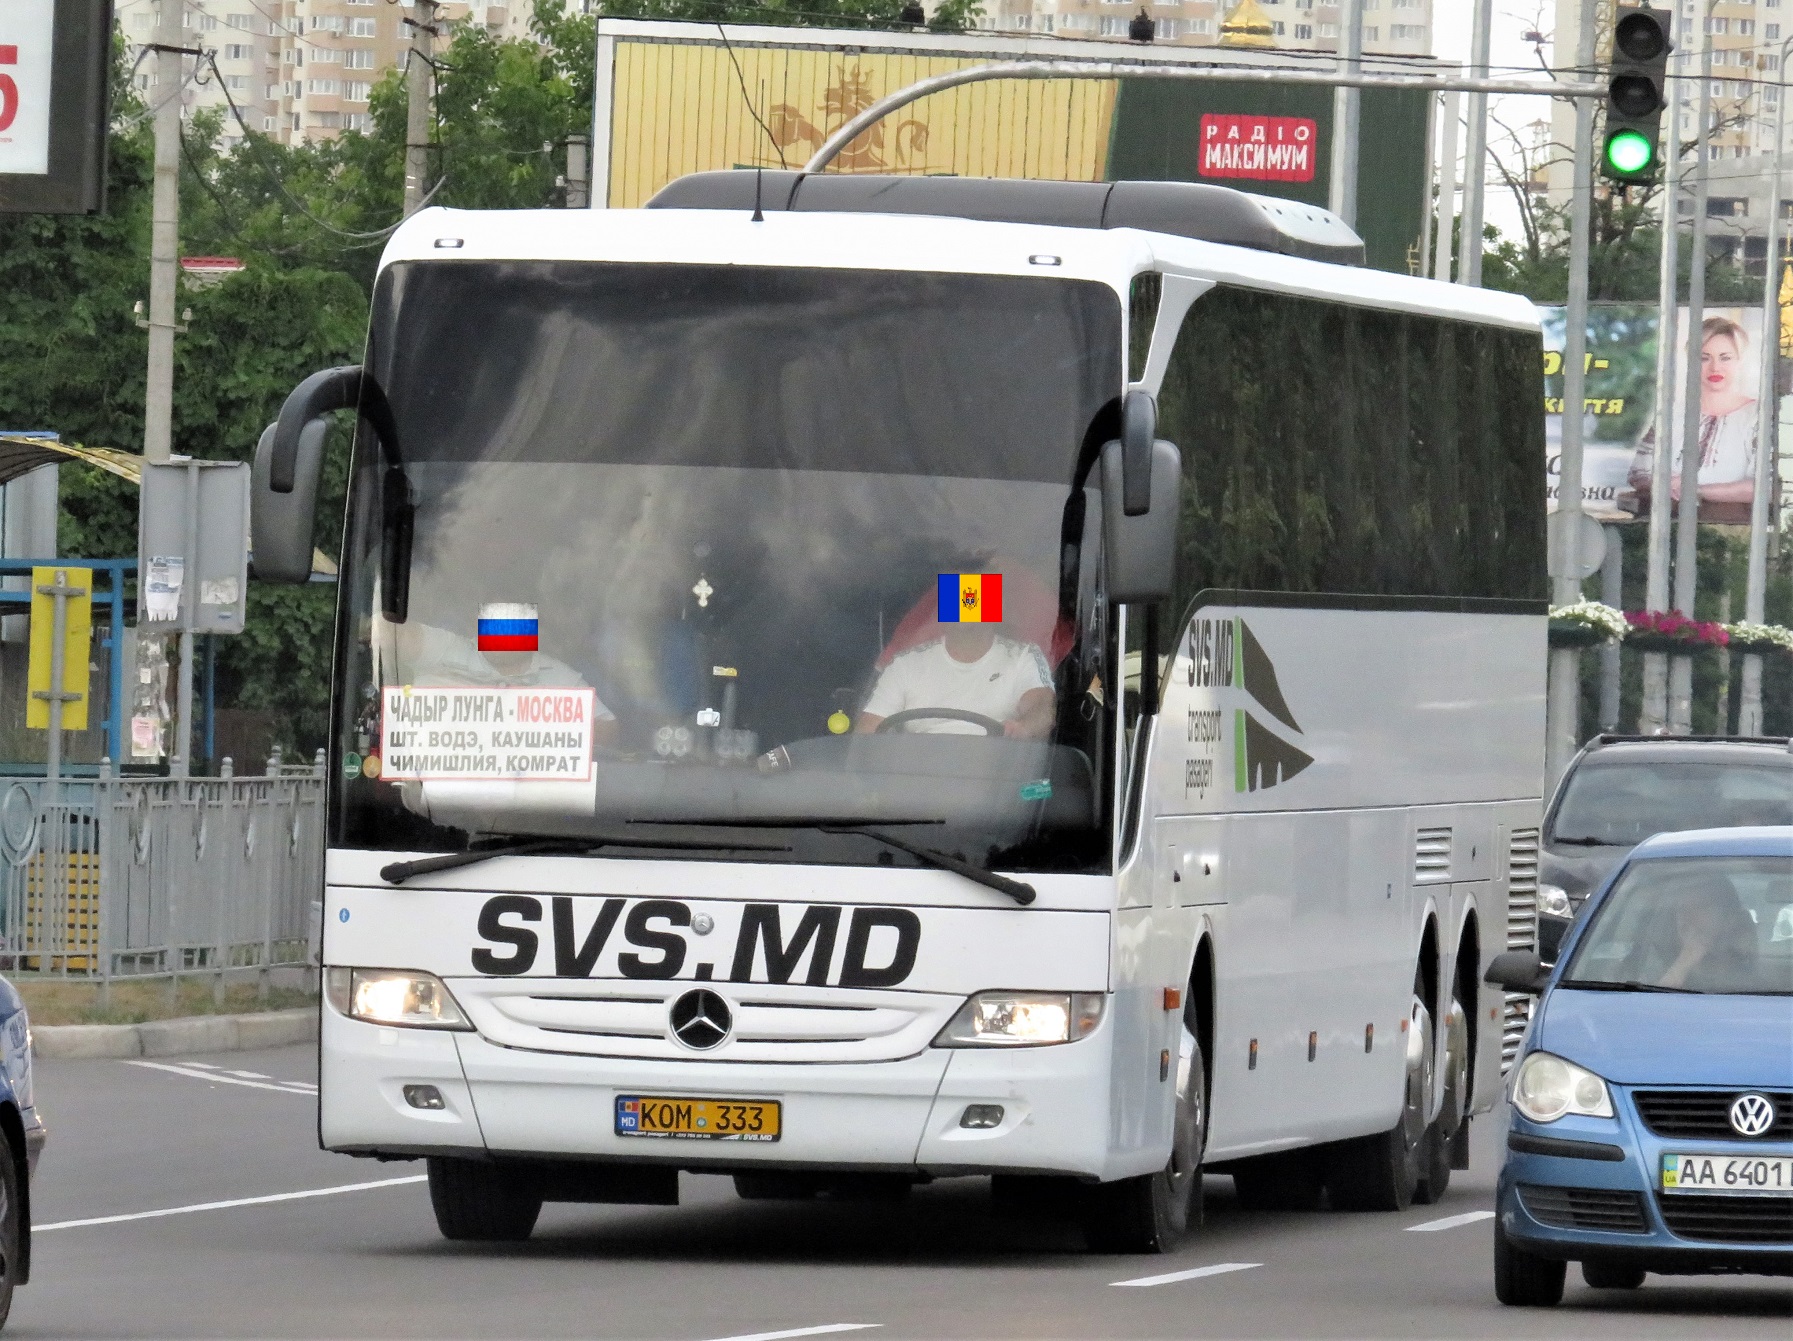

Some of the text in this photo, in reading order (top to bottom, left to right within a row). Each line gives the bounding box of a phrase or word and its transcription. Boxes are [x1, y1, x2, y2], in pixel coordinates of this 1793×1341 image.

[1206, 125, 1310, 143] РАДІО
[1205, 143, 1308, 170] МАКСИМУМ
[1188, 619, 1234, 687] SVS.MD
[390, 695, 448, 727] ЧАДЫР
[452, 695, 504, 722] ЛУНГА
[517, 696, 584, 723] МОСКВА
[390, 731, 583, 753] ШТ. ВОДЭ, КАУШАНЫ
[390, 755, 581, 775] ЧИМИШЛИЯ, КОМРАТ
[471, 895, 921, 988] SVS.MD
[621, 1117, 636, 1127] MD
[641, 1103, 763, 1131] KOM 333
[1680, 1159, 1716, 1185] AA
[1724, 1160, 1782, 1187] 6401
